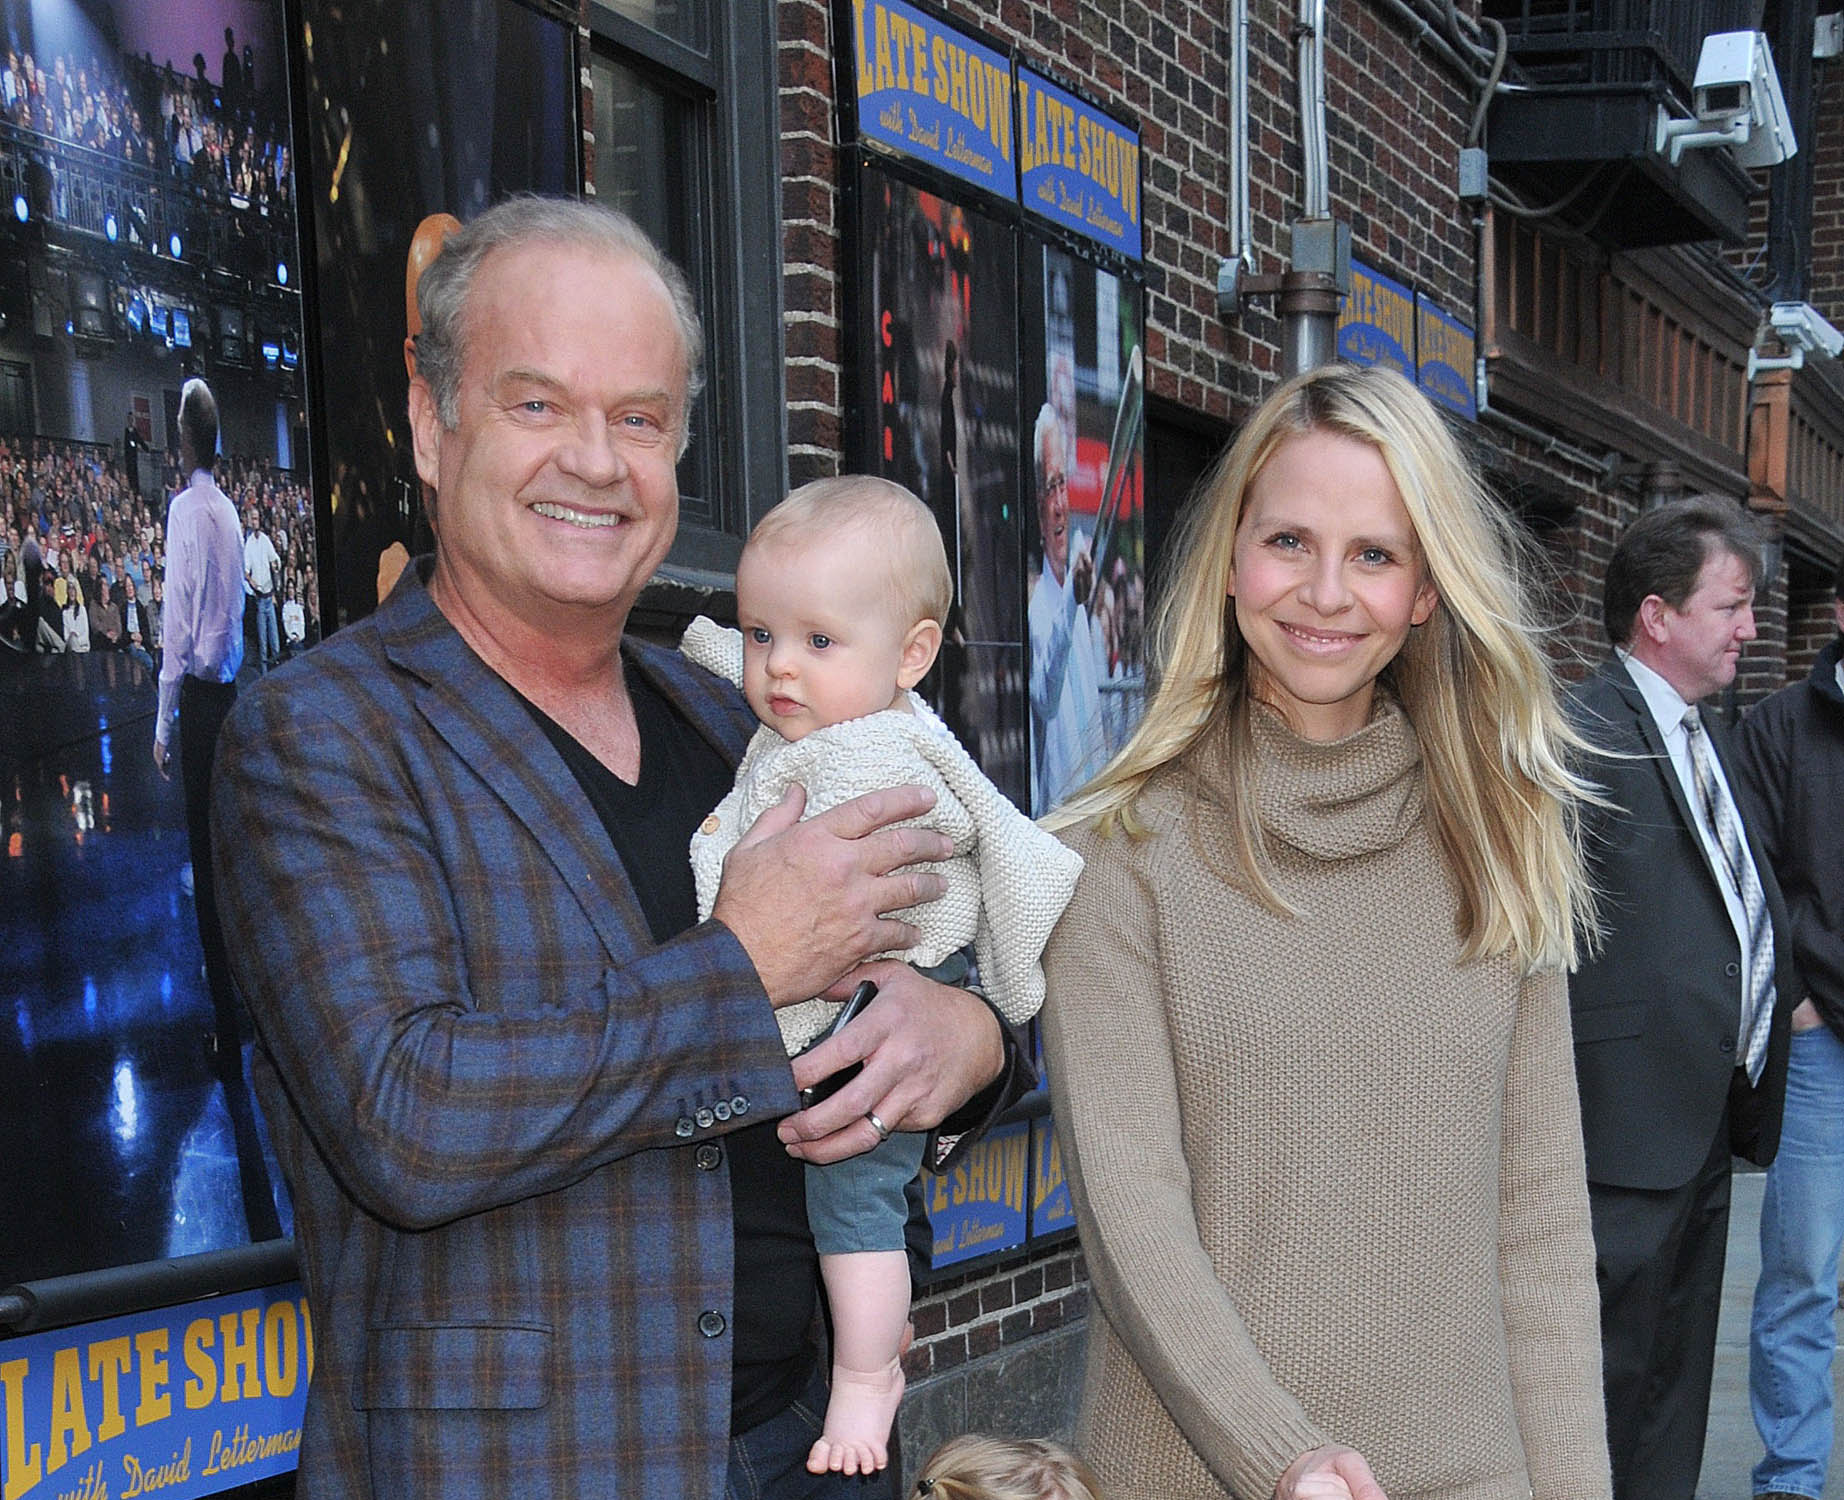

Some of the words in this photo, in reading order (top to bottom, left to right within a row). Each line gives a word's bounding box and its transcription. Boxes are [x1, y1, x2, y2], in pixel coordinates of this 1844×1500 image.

[851, 0, 930, 99] LATE
[932, 34, 1011, 163] SHOW
[879, 100, 904, 136] with
[908, 106, 940, 152] David
[1018, 79, 1076, 174] LATE
[1077, 114, 1139, 225] SHOW
[120, 1436, 192, 1500] David
